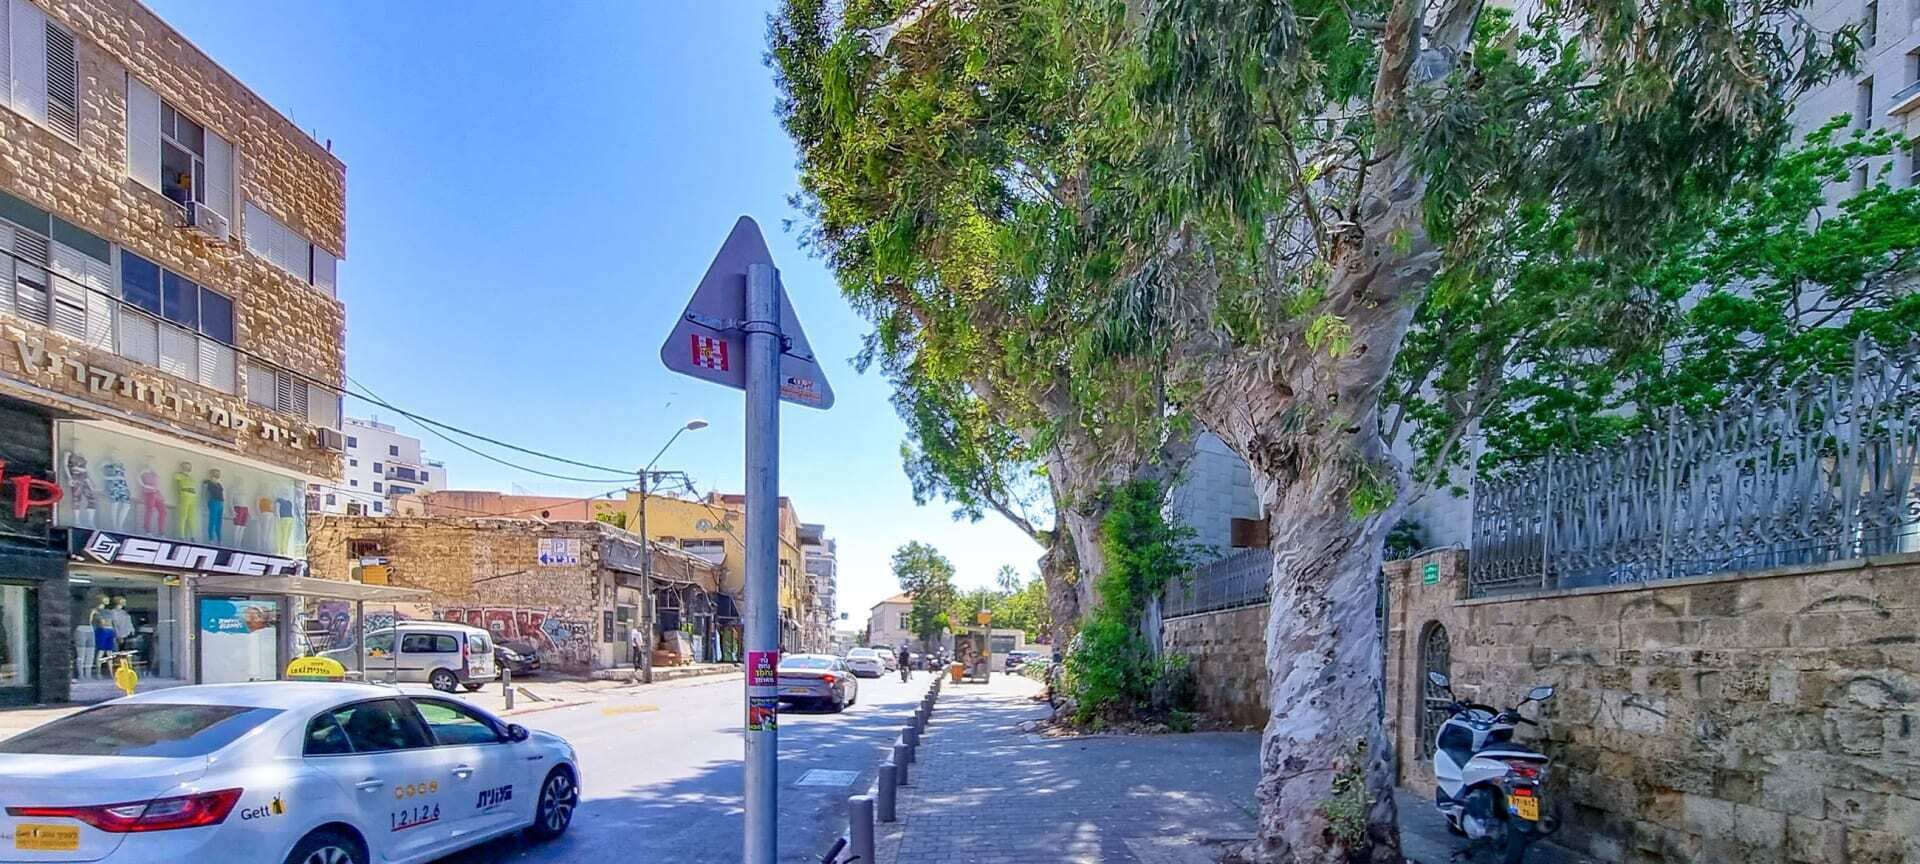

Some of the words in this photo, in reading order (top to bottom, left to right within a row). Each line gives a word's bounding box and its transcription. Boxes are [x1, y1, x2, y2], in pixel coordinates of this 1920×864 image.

[260, 421, 303, 449] בית
[117, 538, 297, 577] SUNJET
[241, 805, 270, 820] Gett
